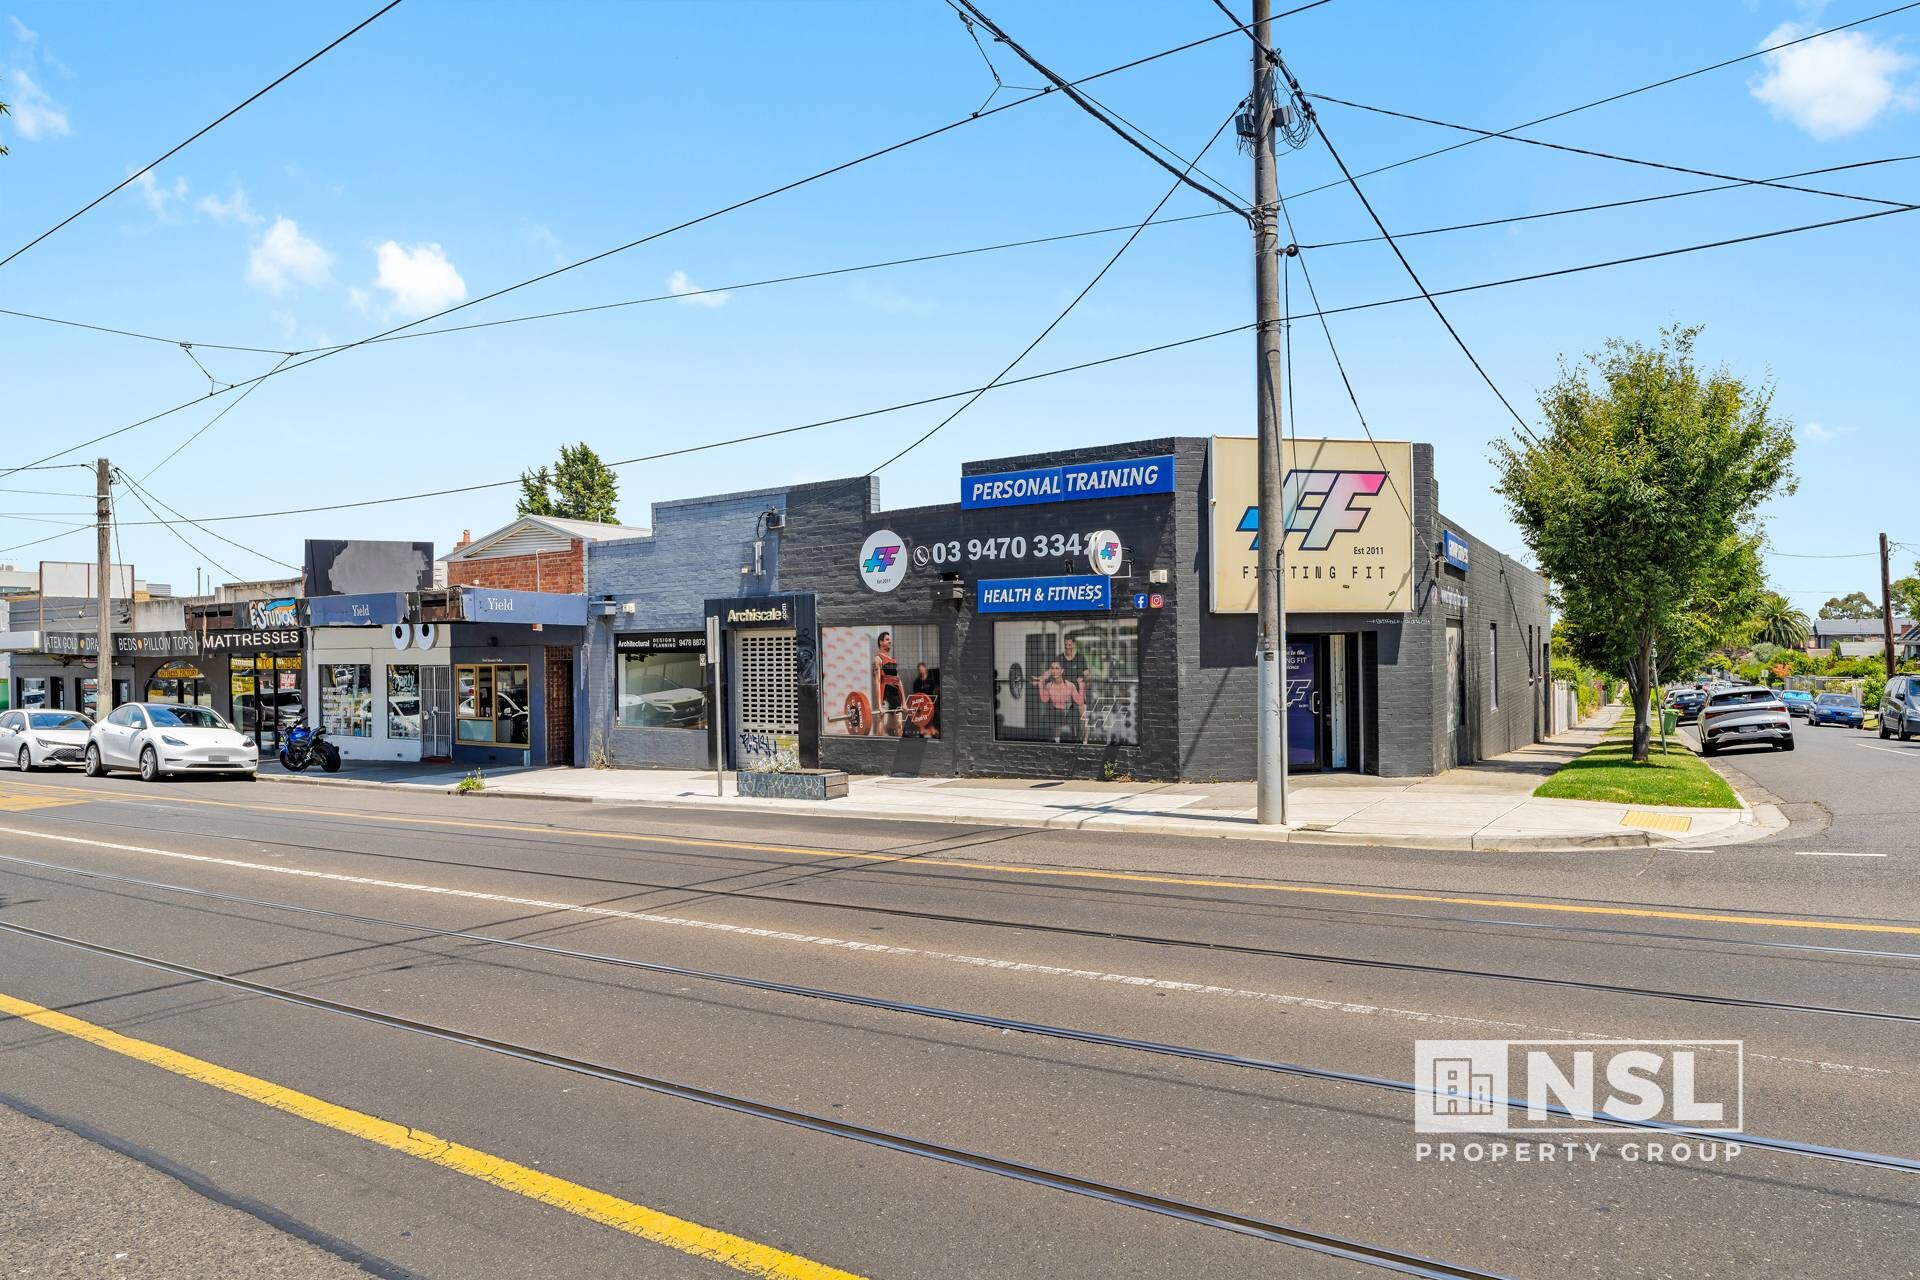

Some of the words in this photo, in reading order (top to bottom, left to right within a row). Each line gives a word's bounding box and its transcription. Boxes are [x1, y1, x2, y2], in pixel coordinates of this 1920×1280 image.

[973, 476, 1060, 501] PERSONAL
[1066, 465, 1159, 492] TRAINING
[932, 541, 961, 564] 03
[967, 536, 1026, 560] 9470
[1354, 547, 1364, 555] Est
[1366, 547, 1384, 555] 2011
[1243, 566, 1336, 579] FITING
[1352, 566, 1385, 579] FIT
[983, 588, 1031, 604] HEALTH
[1034, 587, 1044, 601] &
[1048, 584, 1103, 602] FITNESS
[351, 604, 370, 617] Yield
[488, 597, 513, 611] Yield
[727, 607, 782, 622] Archiscale
[63, 636, 78, 650] GOLD
[118, 637, 138, 651] BEDS
[143, 636, 171, 651] PILLOW
[173, 635, 194, 650] TOPS
[203, 630, 299, 648] MATTRESSES
[618, 640, 650, 648] Architectural
[679, 639, 692, 647] 9478
